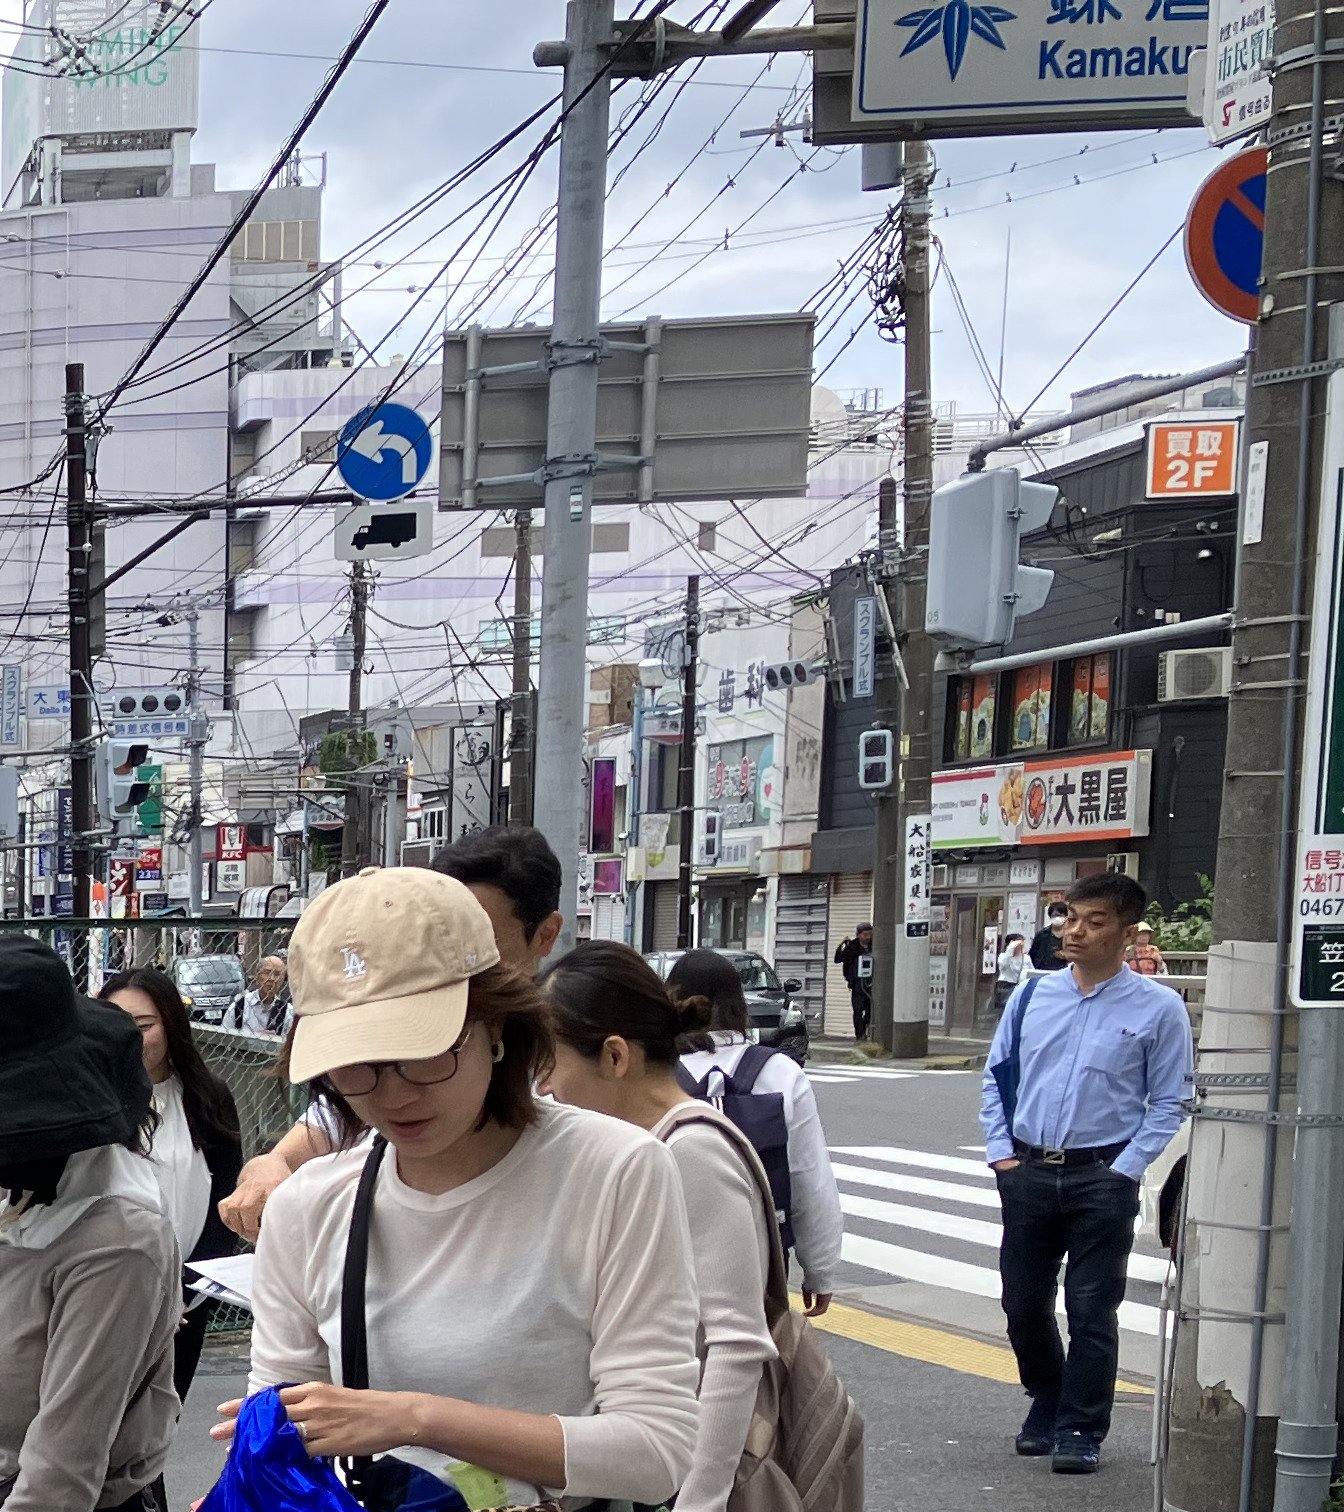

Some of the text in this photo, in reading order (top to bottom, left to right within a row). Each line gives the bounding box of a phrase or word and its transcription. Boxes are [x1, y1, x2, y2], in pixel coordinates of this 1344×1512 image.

[1038, 36, 1207, 80] Kamaku
[1166, 430, 1223, 458] 買取
[1165, 459, 1218, 489] 2F
[858, 603, 872, 693] スクランブル式
[33, 689, 71, 705] 大東
[718, 660, 765, 713] 歯科
[1054, 766, 1129, 827] 大黒屋
[1299, 899, 1344, 916] 0467
